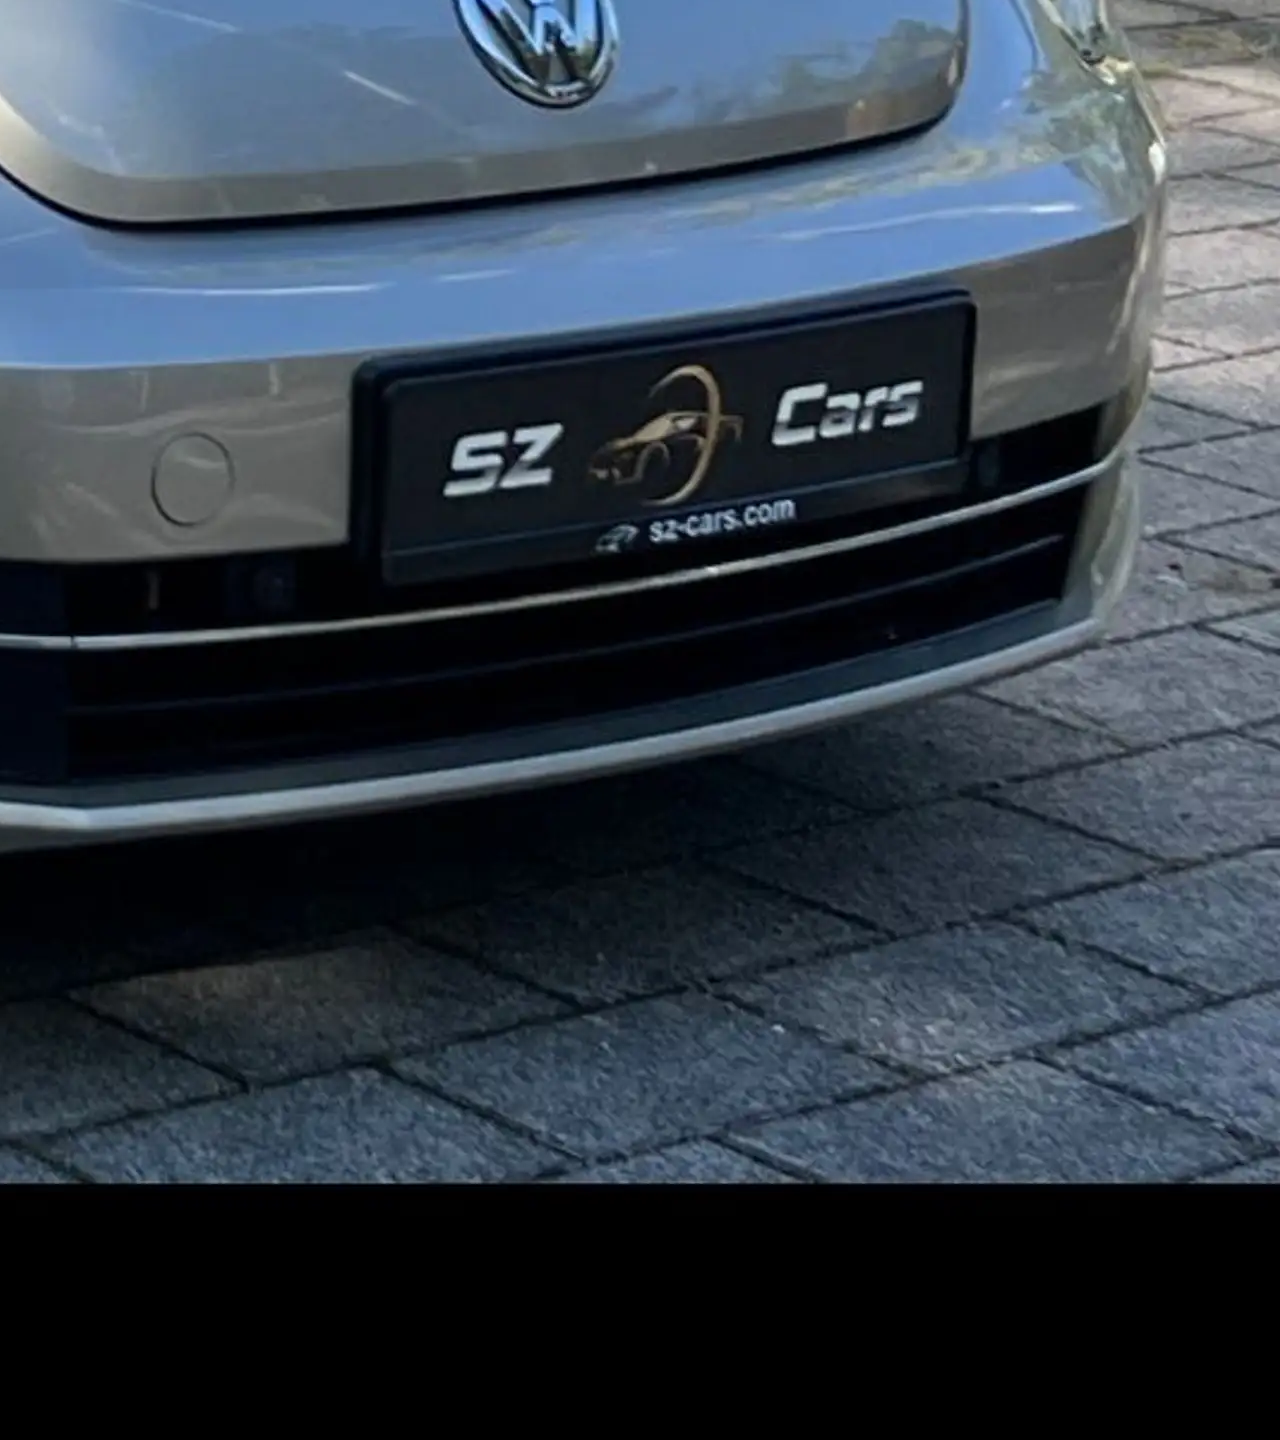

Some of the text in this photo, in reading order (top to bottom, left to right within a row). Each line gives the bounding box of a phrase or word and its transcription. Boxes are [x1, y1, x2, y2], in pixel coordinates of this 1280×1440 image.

[443, 379, 925, 498] SZ Cars
[648, 498, 797, 545] sz-cars.com
